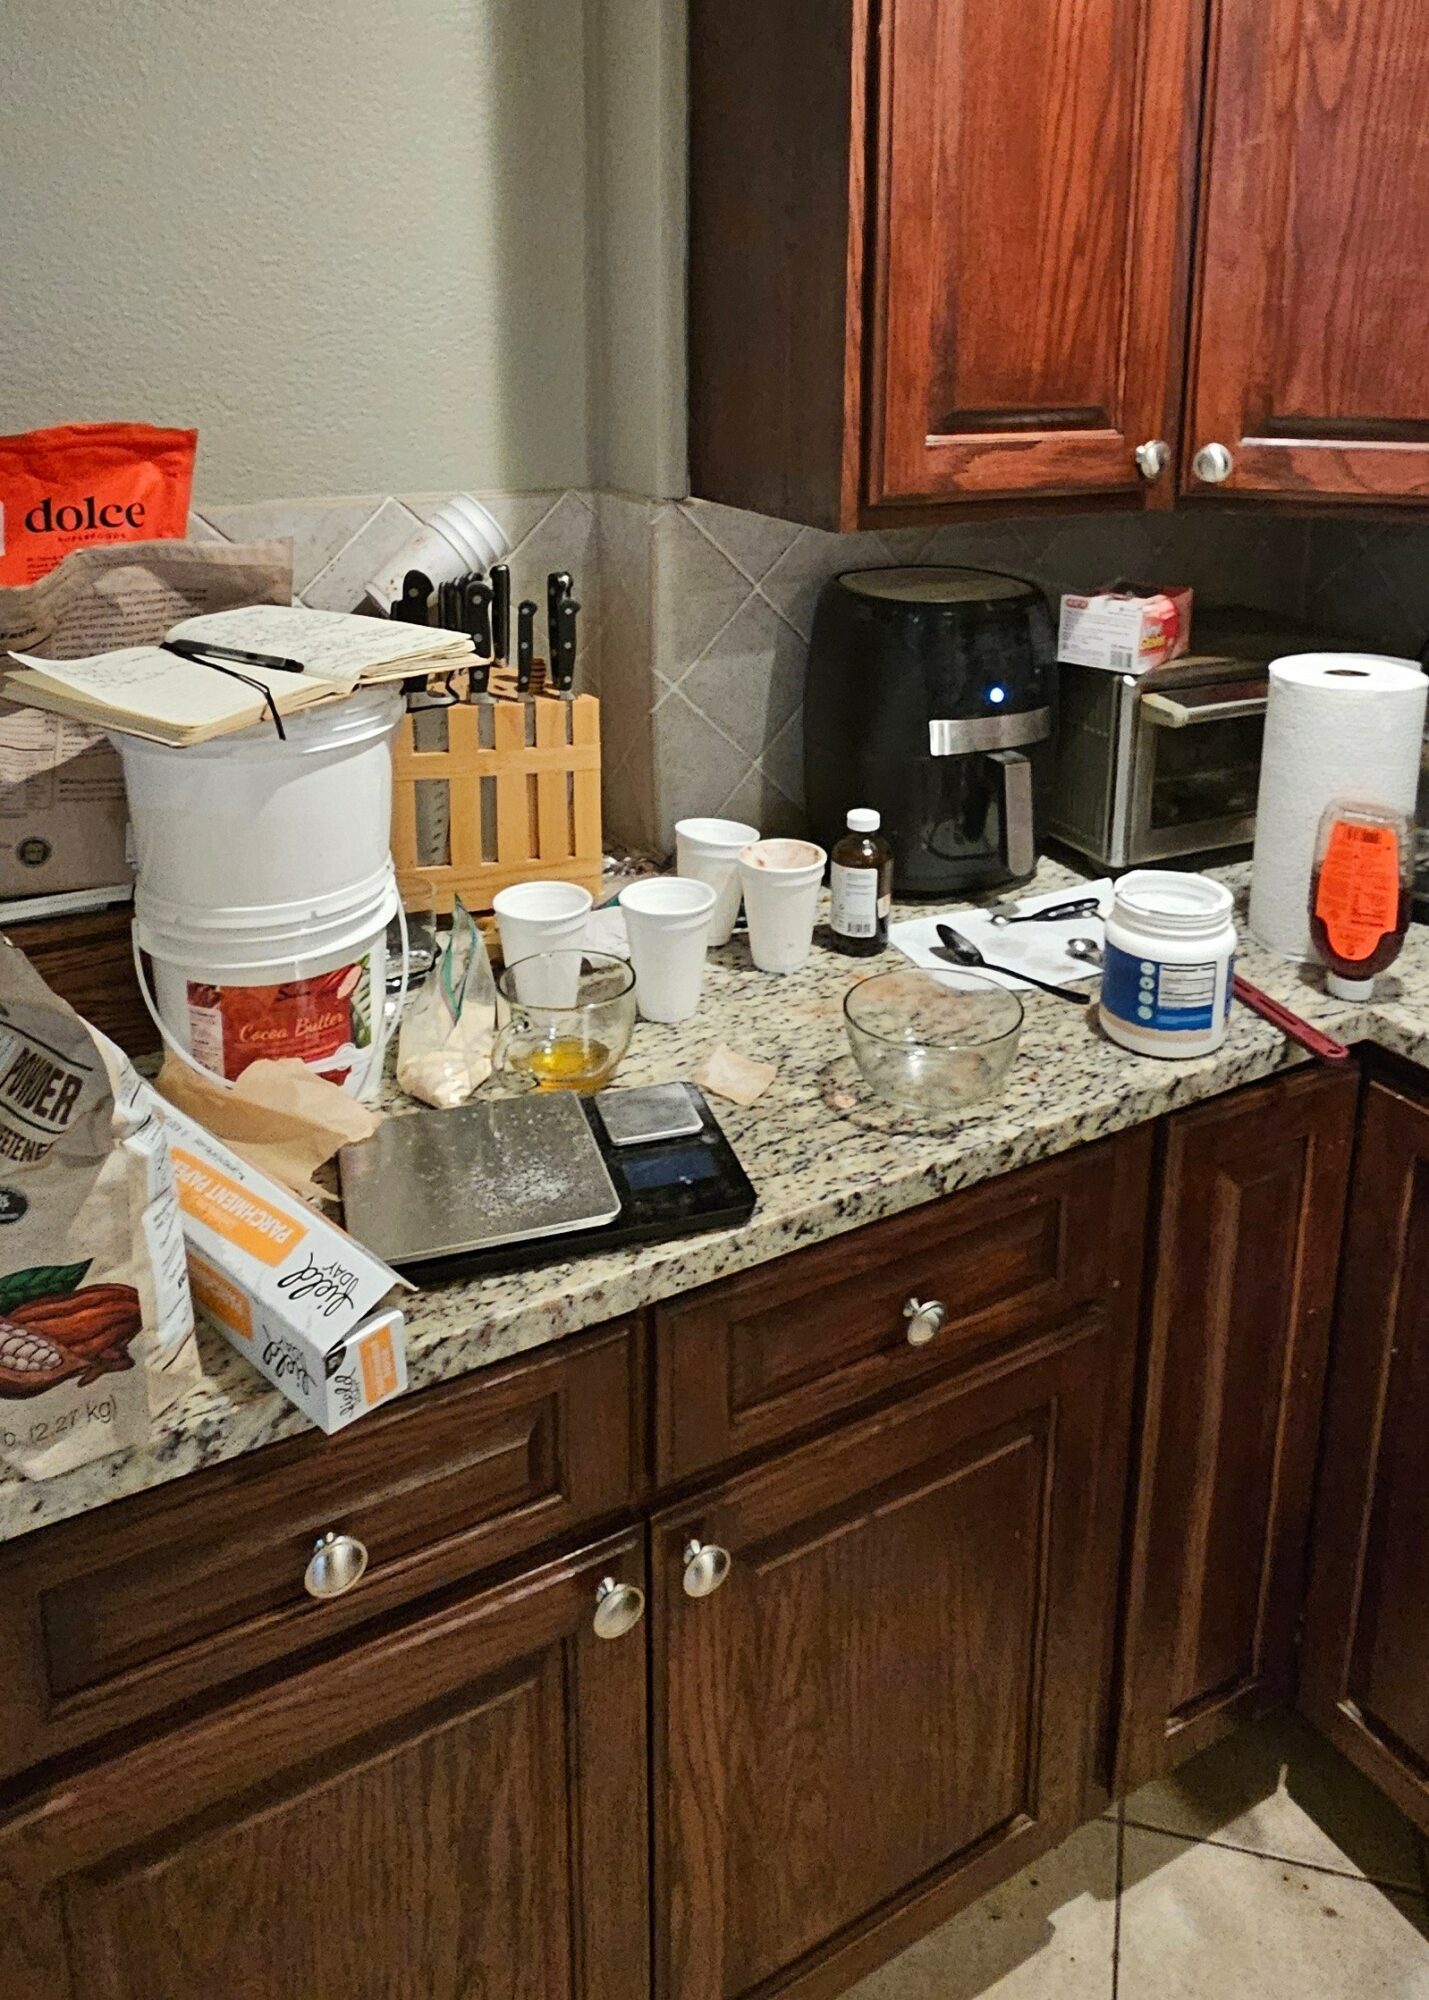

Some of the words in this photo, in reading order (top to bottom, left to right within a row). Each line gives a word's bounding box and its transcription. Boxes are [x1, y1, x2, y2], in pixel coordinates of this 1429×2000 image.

[25, 496, 145, 533] dolce
[239, 1023, 288, 1043] Cocoa
[295, 1012, 344, 1037] Butter
[0, 1046, 84, 1126] POWDER
[175, 1159, 212, 1193] PAPE
[203, 1183, 294, 1244] PARCHMENT
[323, 1261, 356, 1287] DAY
[86, 1394, 117, 1424] kg)
